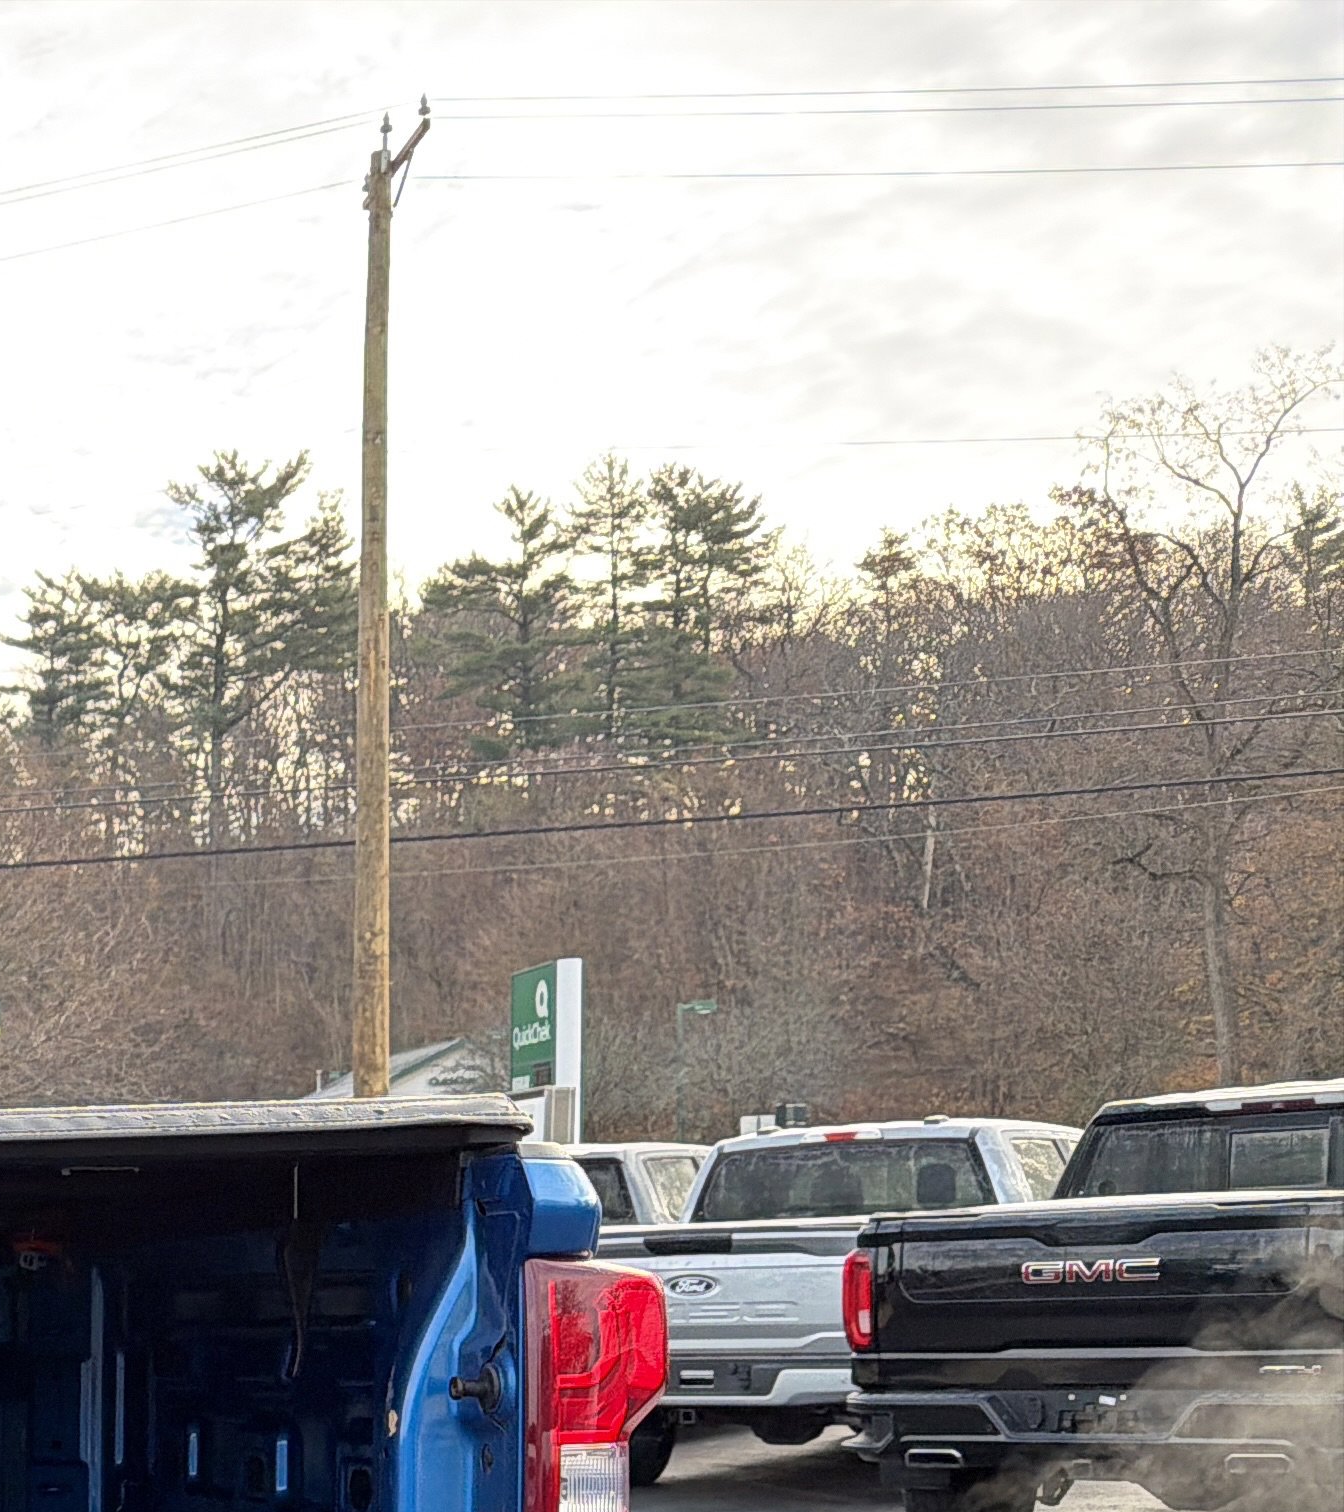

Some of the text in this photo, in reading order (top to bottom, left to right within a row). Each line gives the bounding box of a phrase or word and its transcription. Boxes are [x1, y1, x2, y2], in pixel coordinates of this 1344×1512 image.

[513, 1020, 551, 1050] QuickChek
[1021, 1257, 1162, 1285] GMC
[675, 1278, 708, 1293] Ford
